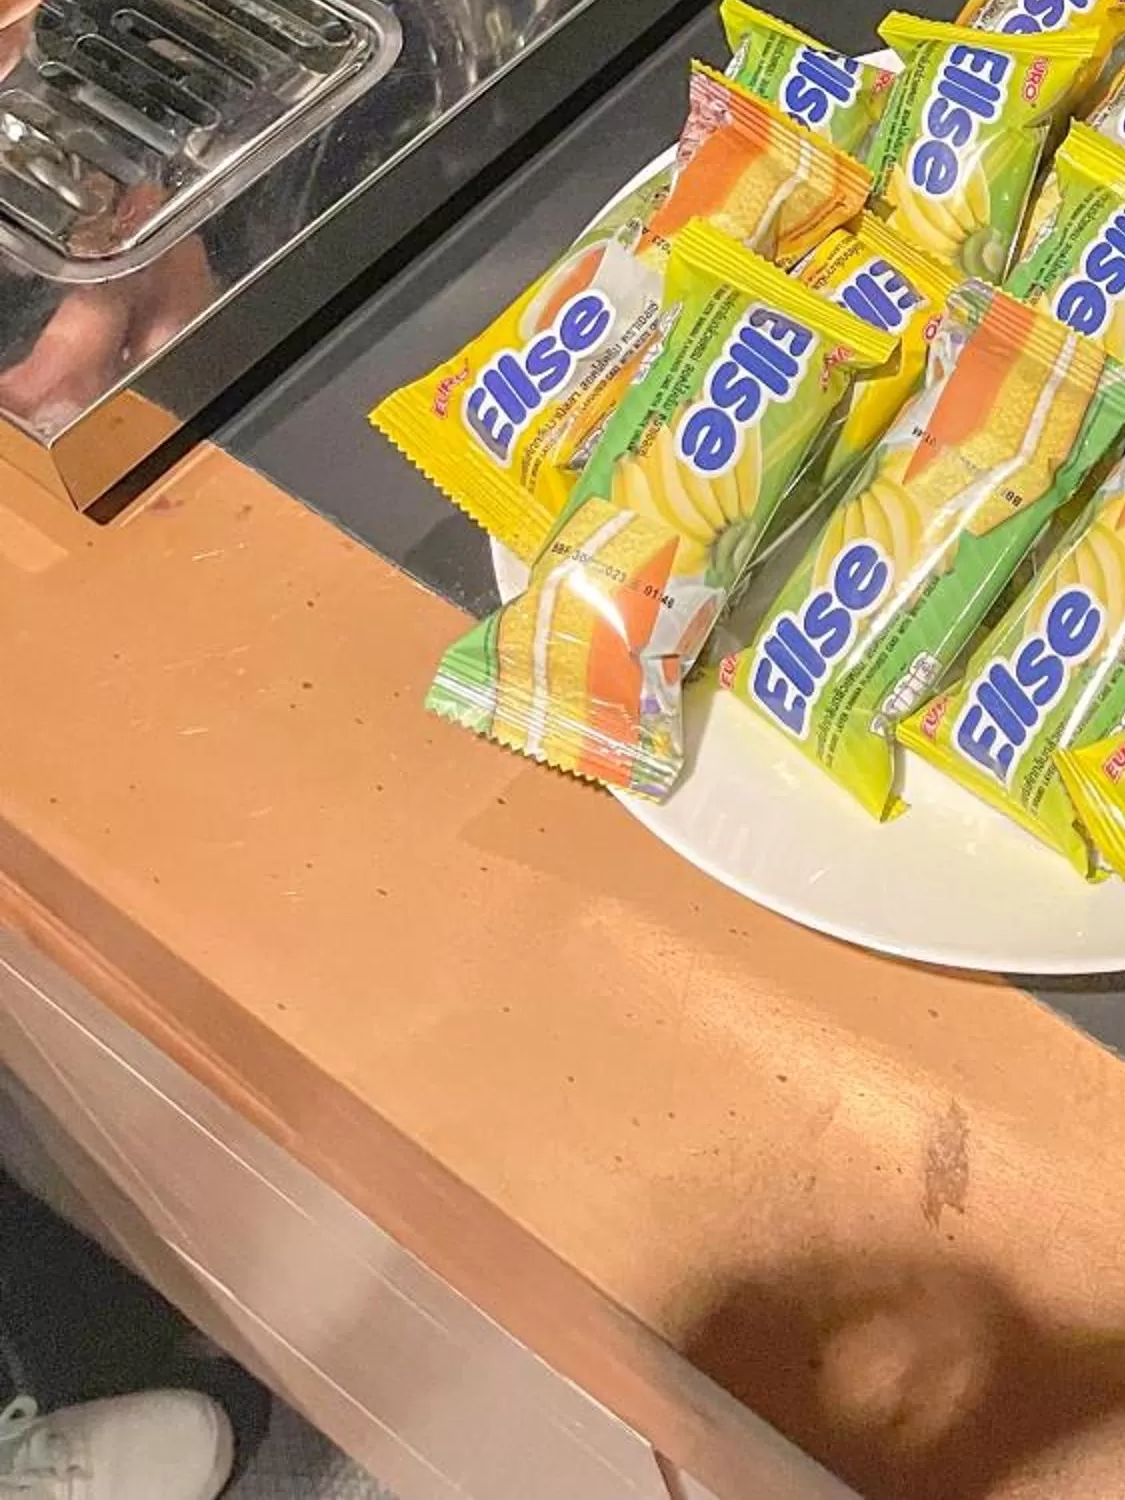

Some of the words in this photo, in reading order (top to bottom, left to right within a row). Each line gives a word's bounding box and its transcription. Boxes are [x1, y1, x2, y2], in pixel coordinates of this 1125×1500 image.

[912, 45, 1009, 195] Ellse
[1022, 56, 1048, 101] URO
[468, 295, 611, 462] Ellse
[681, 308, 813, 471] Ellse
[754, 544, 888, 736] Ellse
[957, 590, 1101, 783] Ellse
